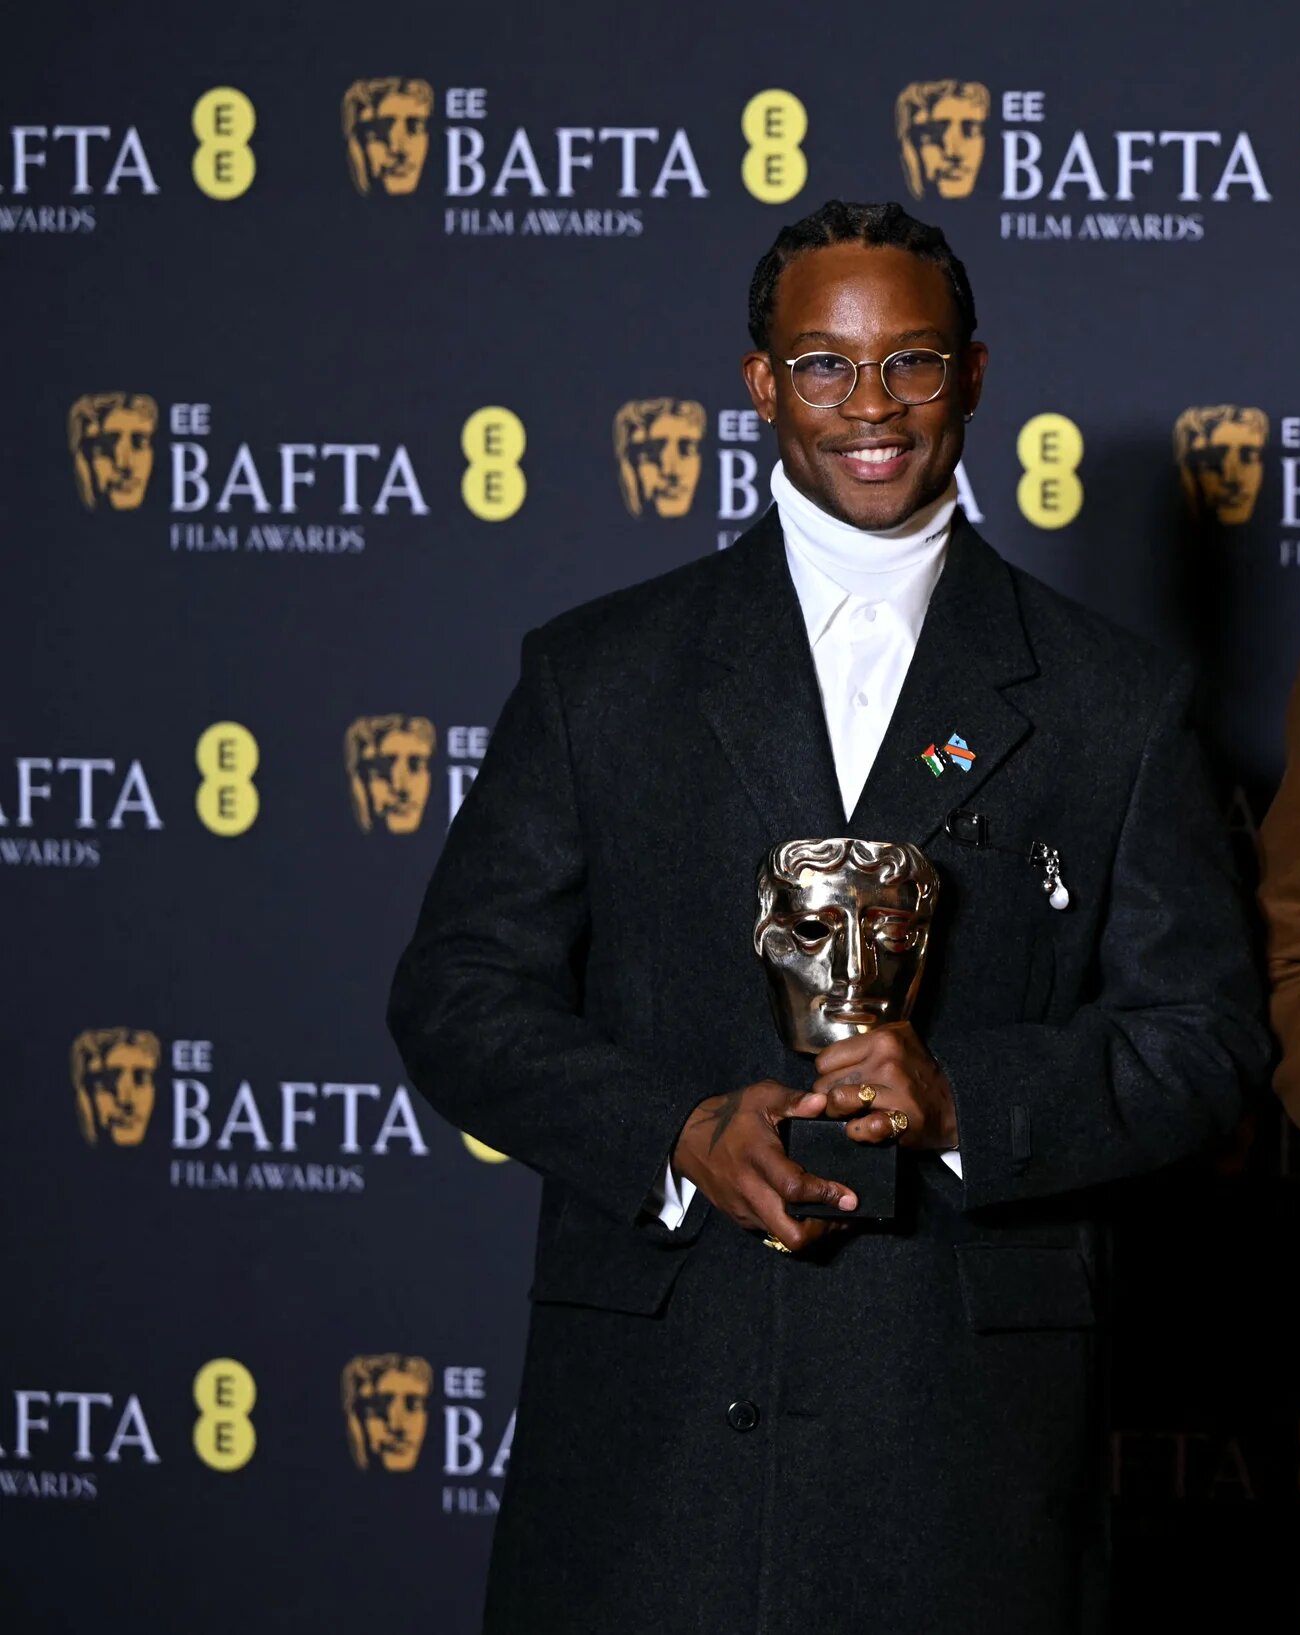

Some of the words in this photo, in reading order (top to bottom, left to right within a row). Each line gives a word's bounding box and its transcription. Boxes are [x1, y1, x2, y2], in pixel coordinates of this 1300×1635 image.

[445, 87, 487, 120] EE
[1001, 90, 1046, 123] EE
[0, 122, 162, 197] FTA
[446, 126, 709, 199] BAFTA
[1001, 129, 1272, 203] BAFTA
[444, 208, 515, 235] FILM
[523, 208, 644, 236] AWARDS
[999, 212, 1073, 240] FILM
[1080, 213, 1205, 240] AWARDS
[169, 402, 211, 436] EE
[717, 408, 761, 443] EE
[171, 442, 429, 516] BAFTA
[169, 523, 239, 551] FILM
[249, 525, 365, 552] AWARDS
[446, 725, 490, 759] EE
[0, 754, 165, 831] FTA
[171, 1039, 212, 1073] EE
[172, 1078, 428, 1156] BAFTA
[170, 1160, 239, 1187] FILM
[250, 1164, 365, 1190] AWARDS
[443, 1365, 485, 1400] EE
[0, 1386, 162, 1466] FTA
